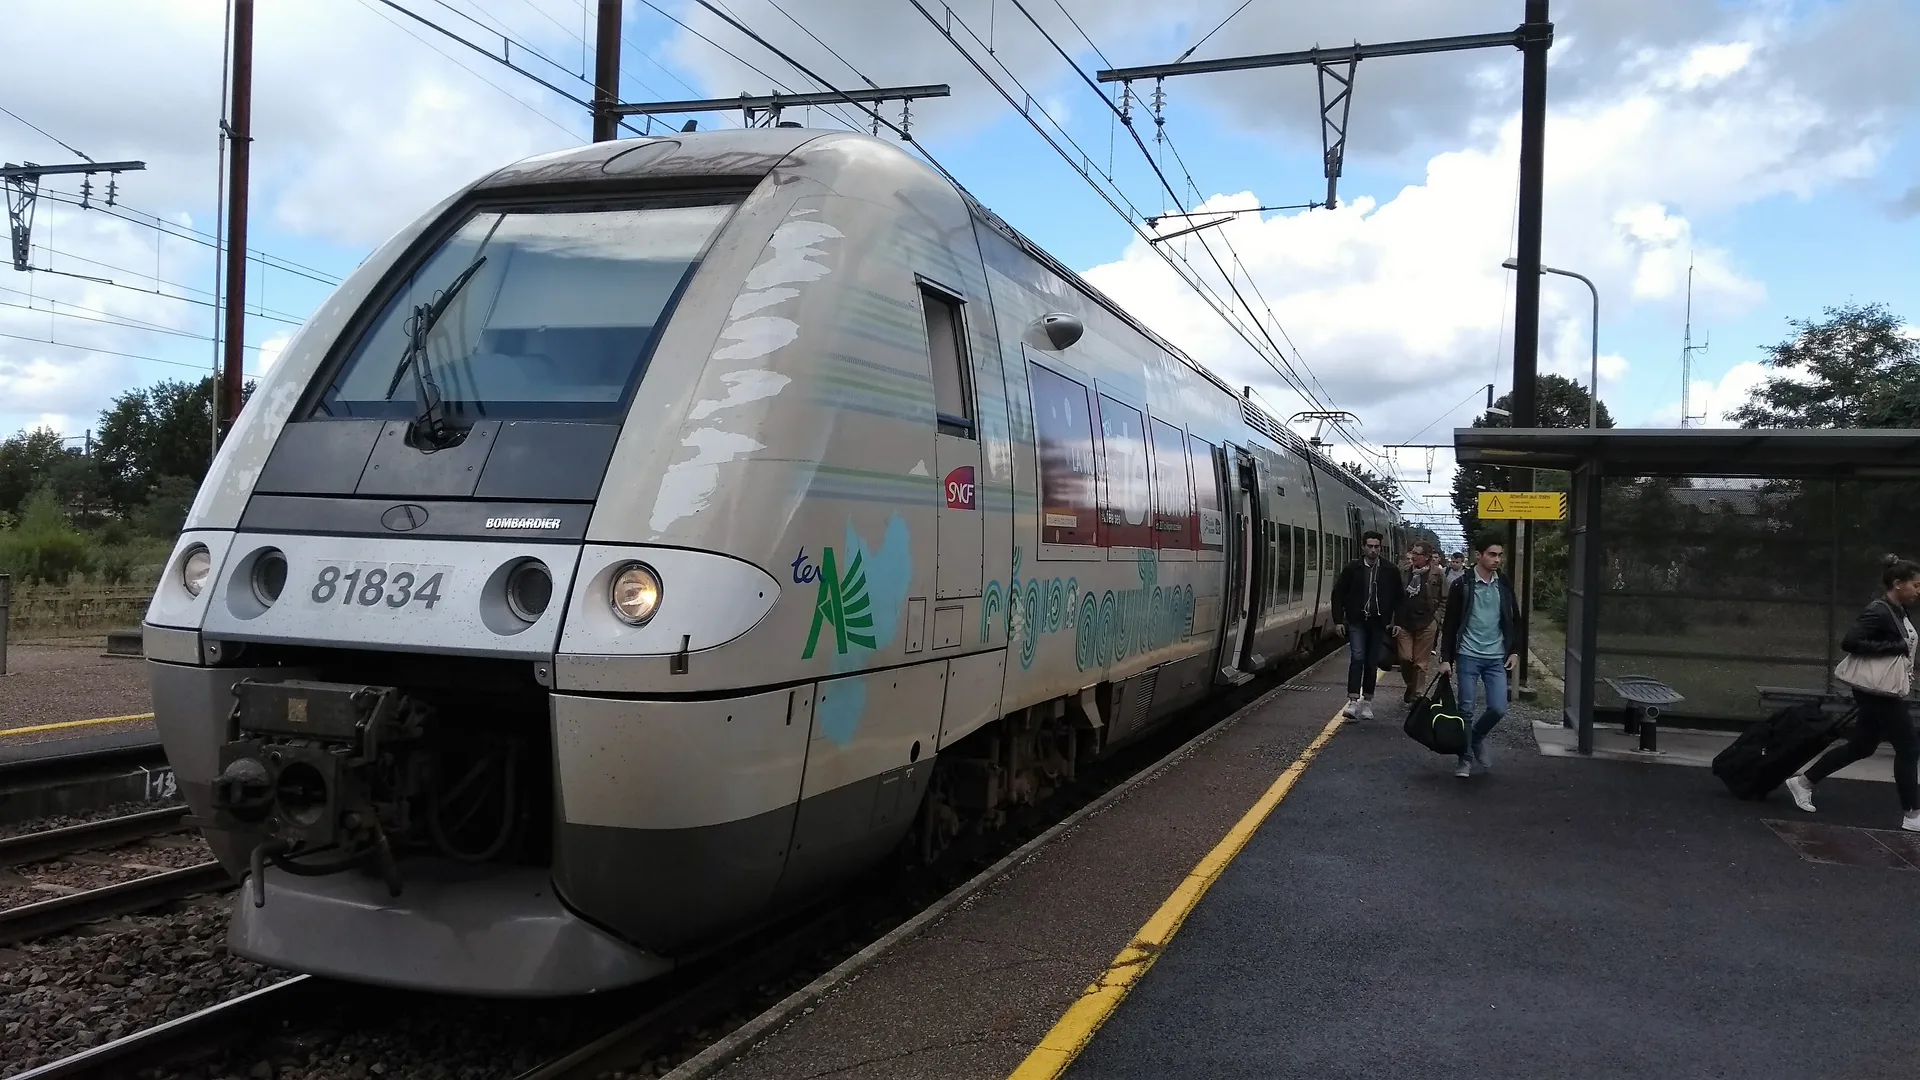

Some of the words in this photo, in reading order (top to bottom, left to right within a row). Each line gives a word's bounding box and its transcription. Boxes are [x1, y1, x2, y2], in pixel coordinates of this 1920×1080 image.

[948, 481, 974, 504] SNCF
[485, 517, 562, 529] BOMBARDIER
[311, 565, 444, 609] 81834
